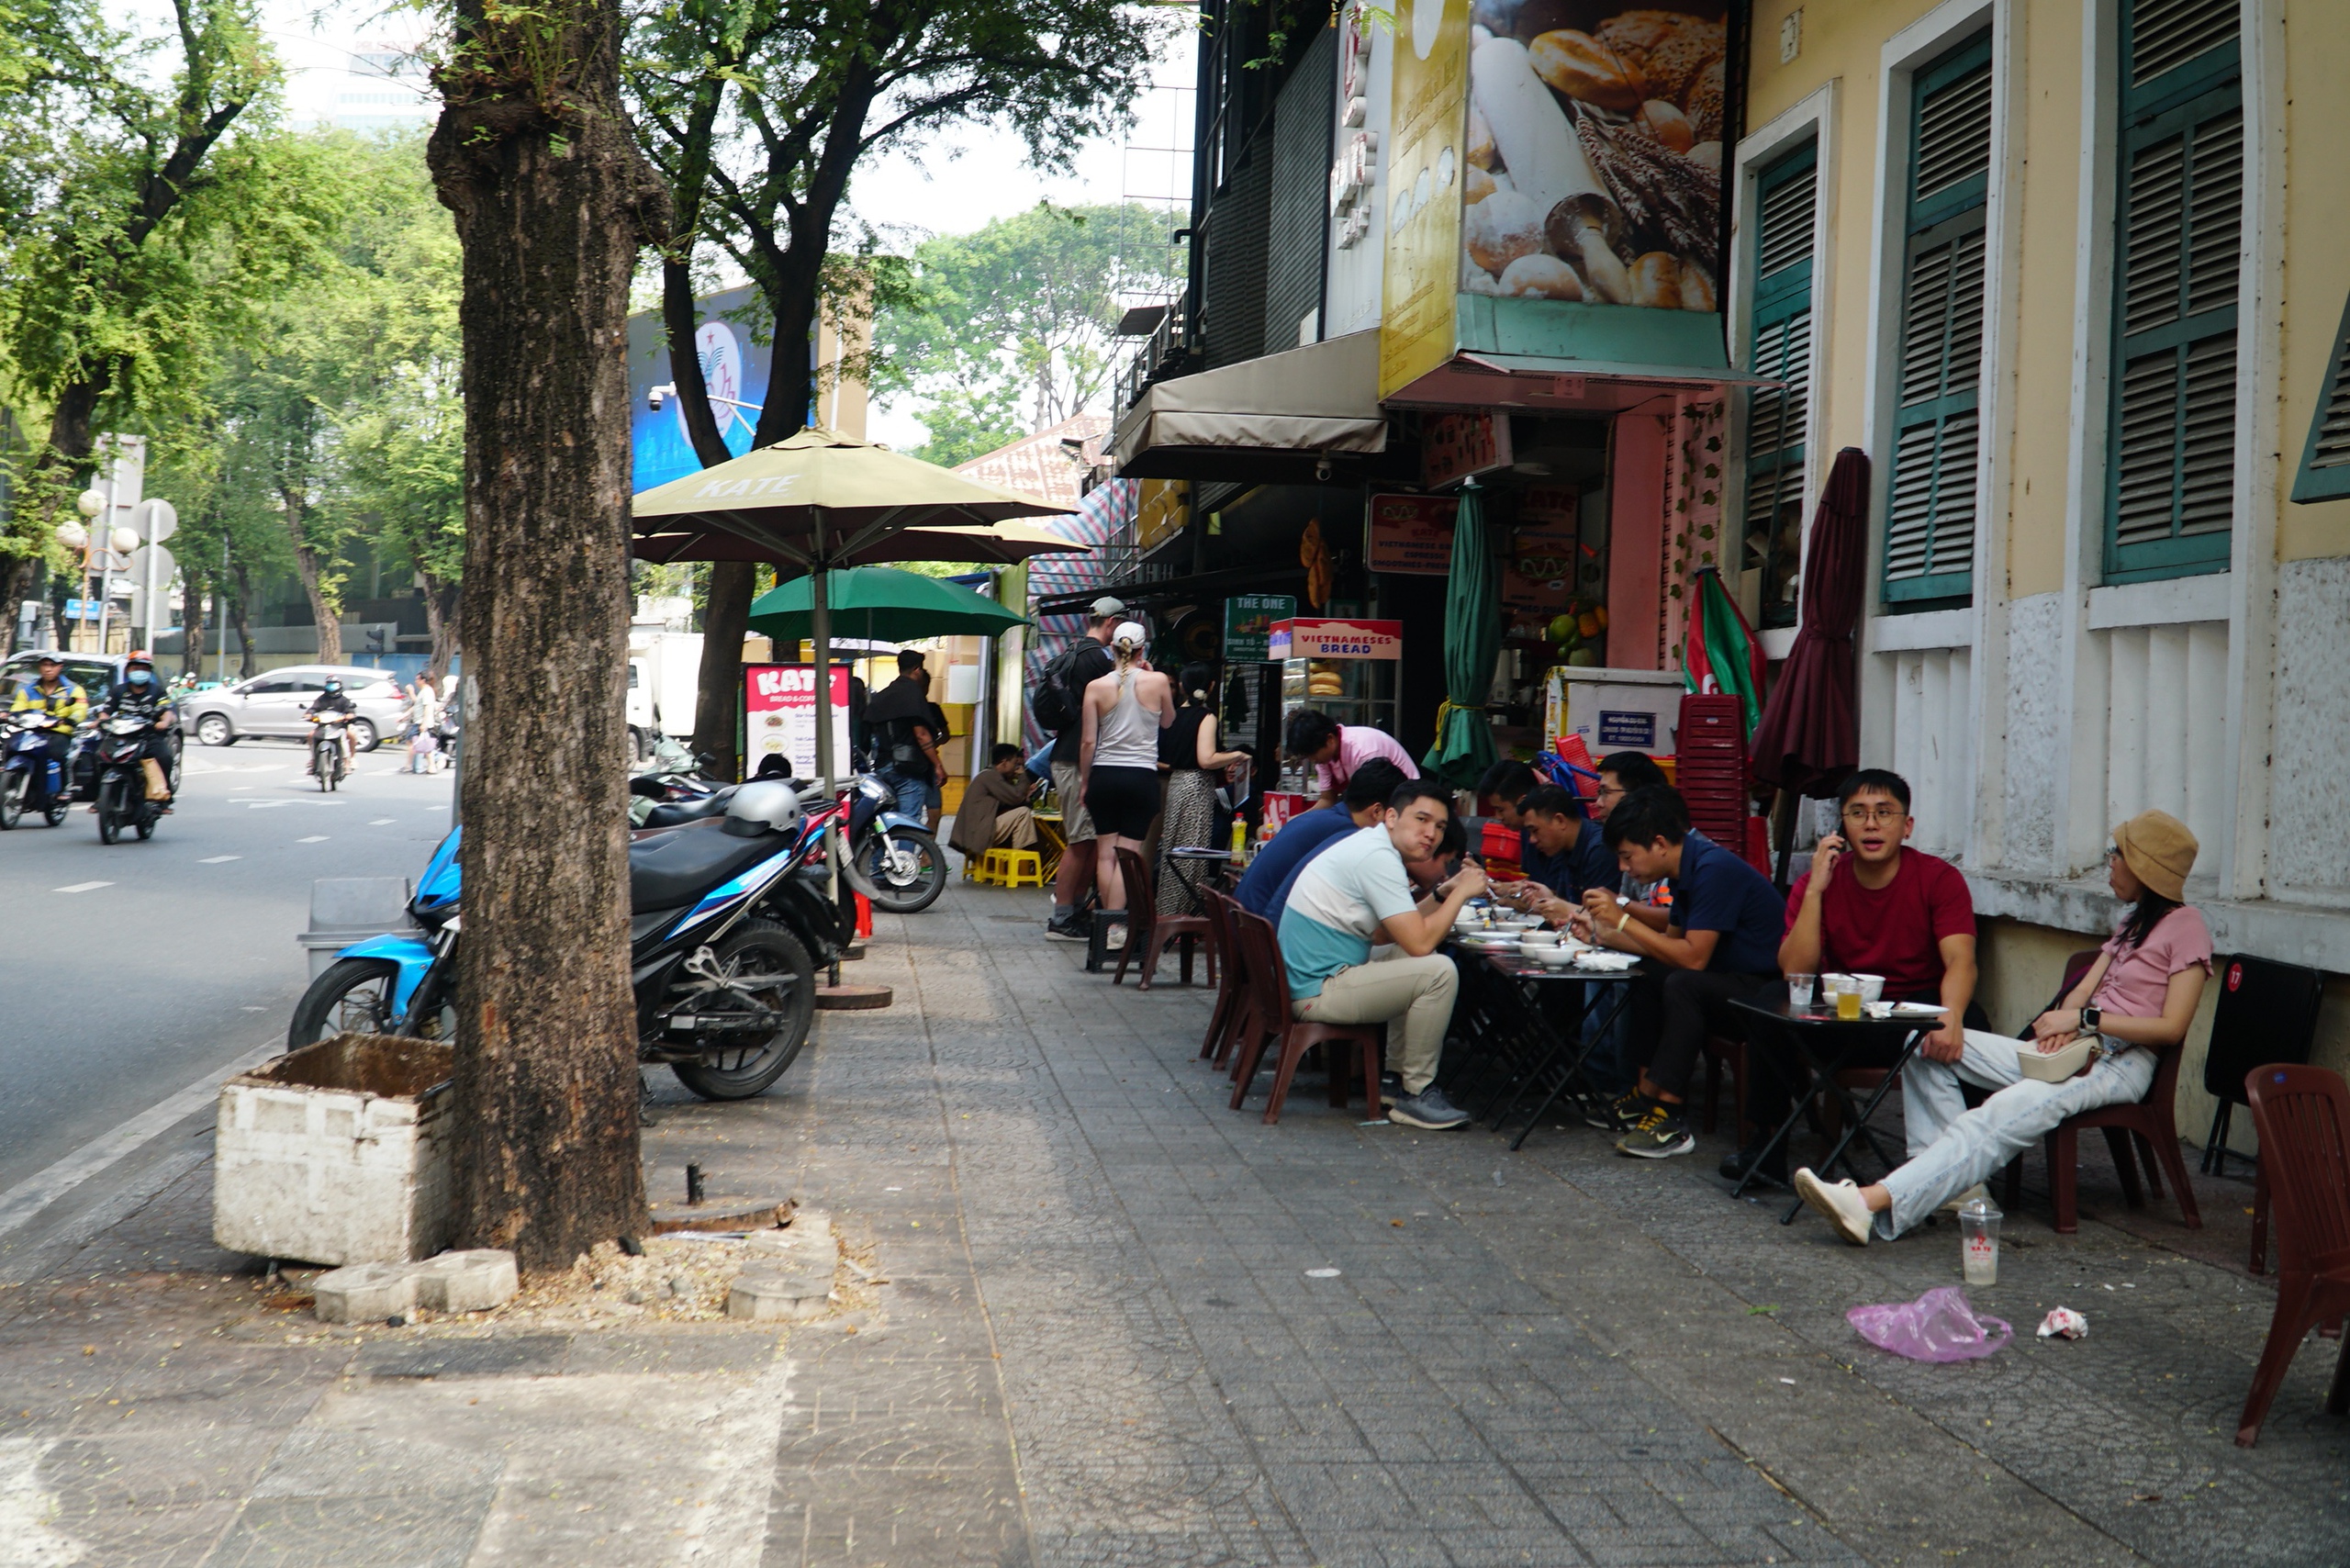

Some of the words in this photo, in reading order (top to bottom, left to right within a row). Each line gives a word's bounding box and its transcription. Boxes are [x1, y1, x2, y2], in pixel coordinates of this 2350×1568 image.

[694, 474, 801, 498] KATE
[1379, 541, 1436, 549] VIETNAMESE
[1237, 598, 1259, 609] THE
[1261, 598, 1286, 610] ONE
[1301, 634, 1392, 644] VIETNAMESES
[1321, 644, 1371, 654] BREAD
[2231, 970, 2241, 985] 17
